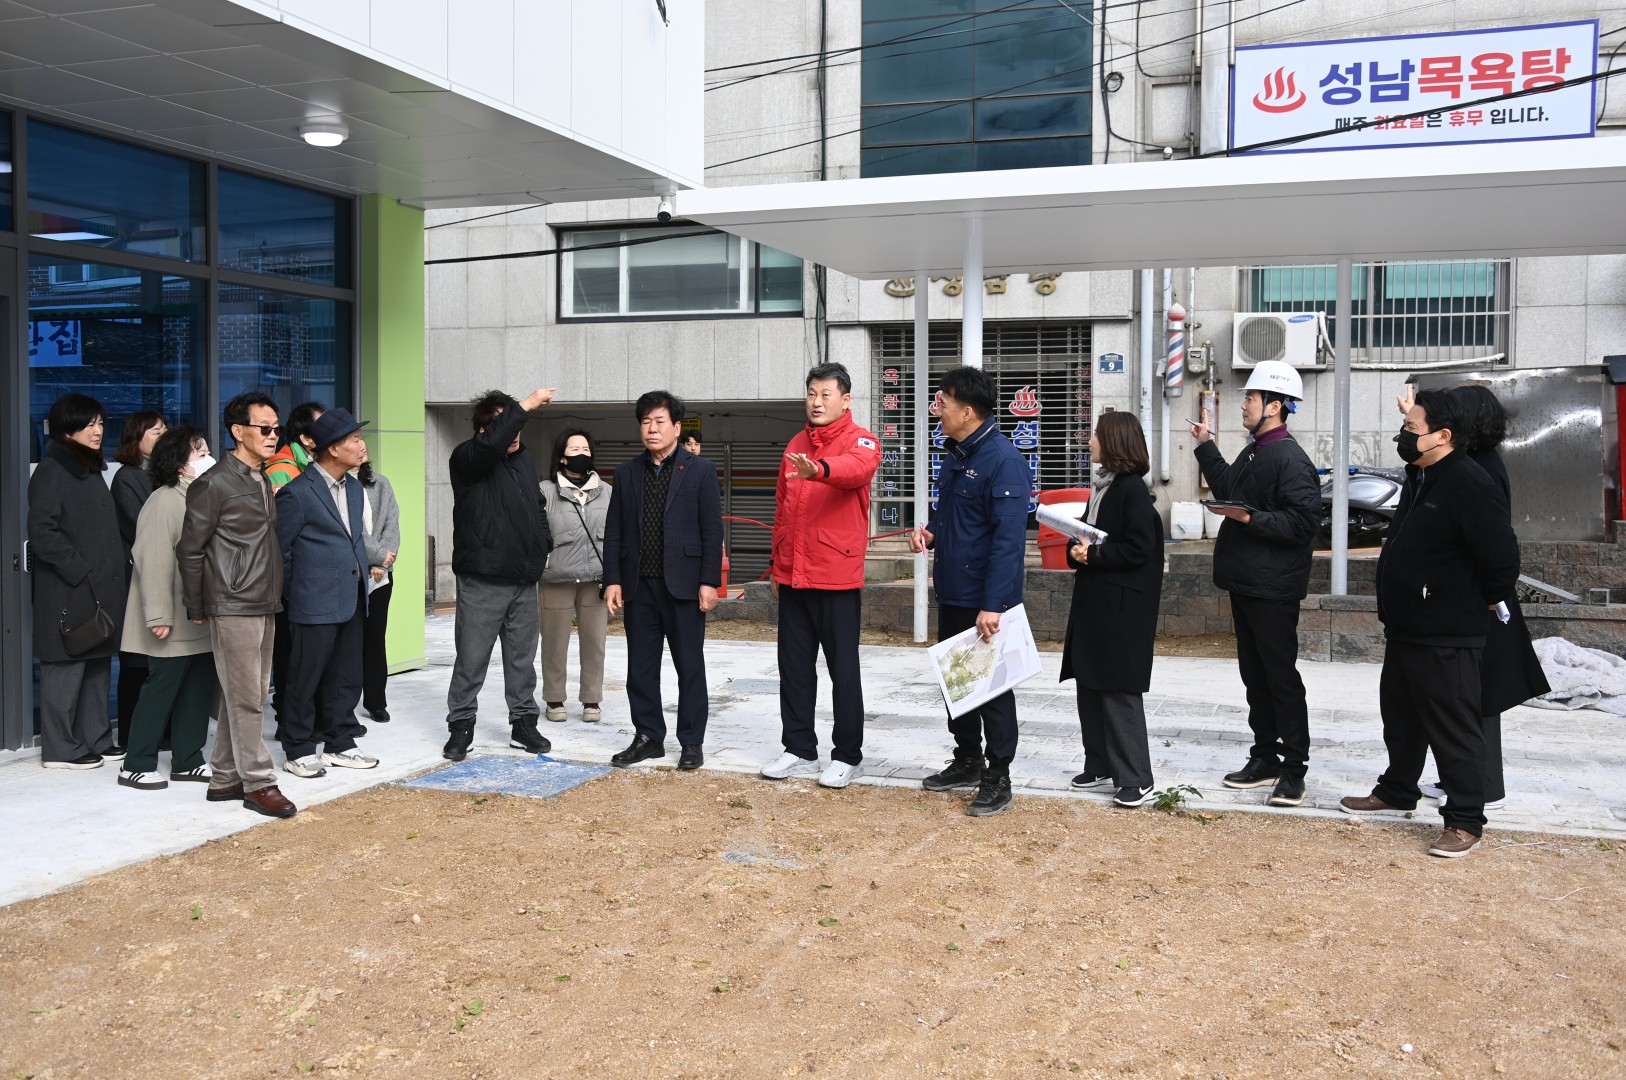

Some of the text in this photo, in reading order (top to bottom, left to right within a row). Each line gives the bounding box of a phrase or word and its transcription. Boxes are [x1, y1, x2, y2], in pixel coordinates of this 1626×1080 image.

[1318, 47, 1572, 105] 성남목욕탕
[1335, 116, 1368, 132] 매주
[1449, 110, 1483, 127] 휴무
[1490, 106, 1549, 125] 입니다.
[1108, 362, 1115, 371] 9
